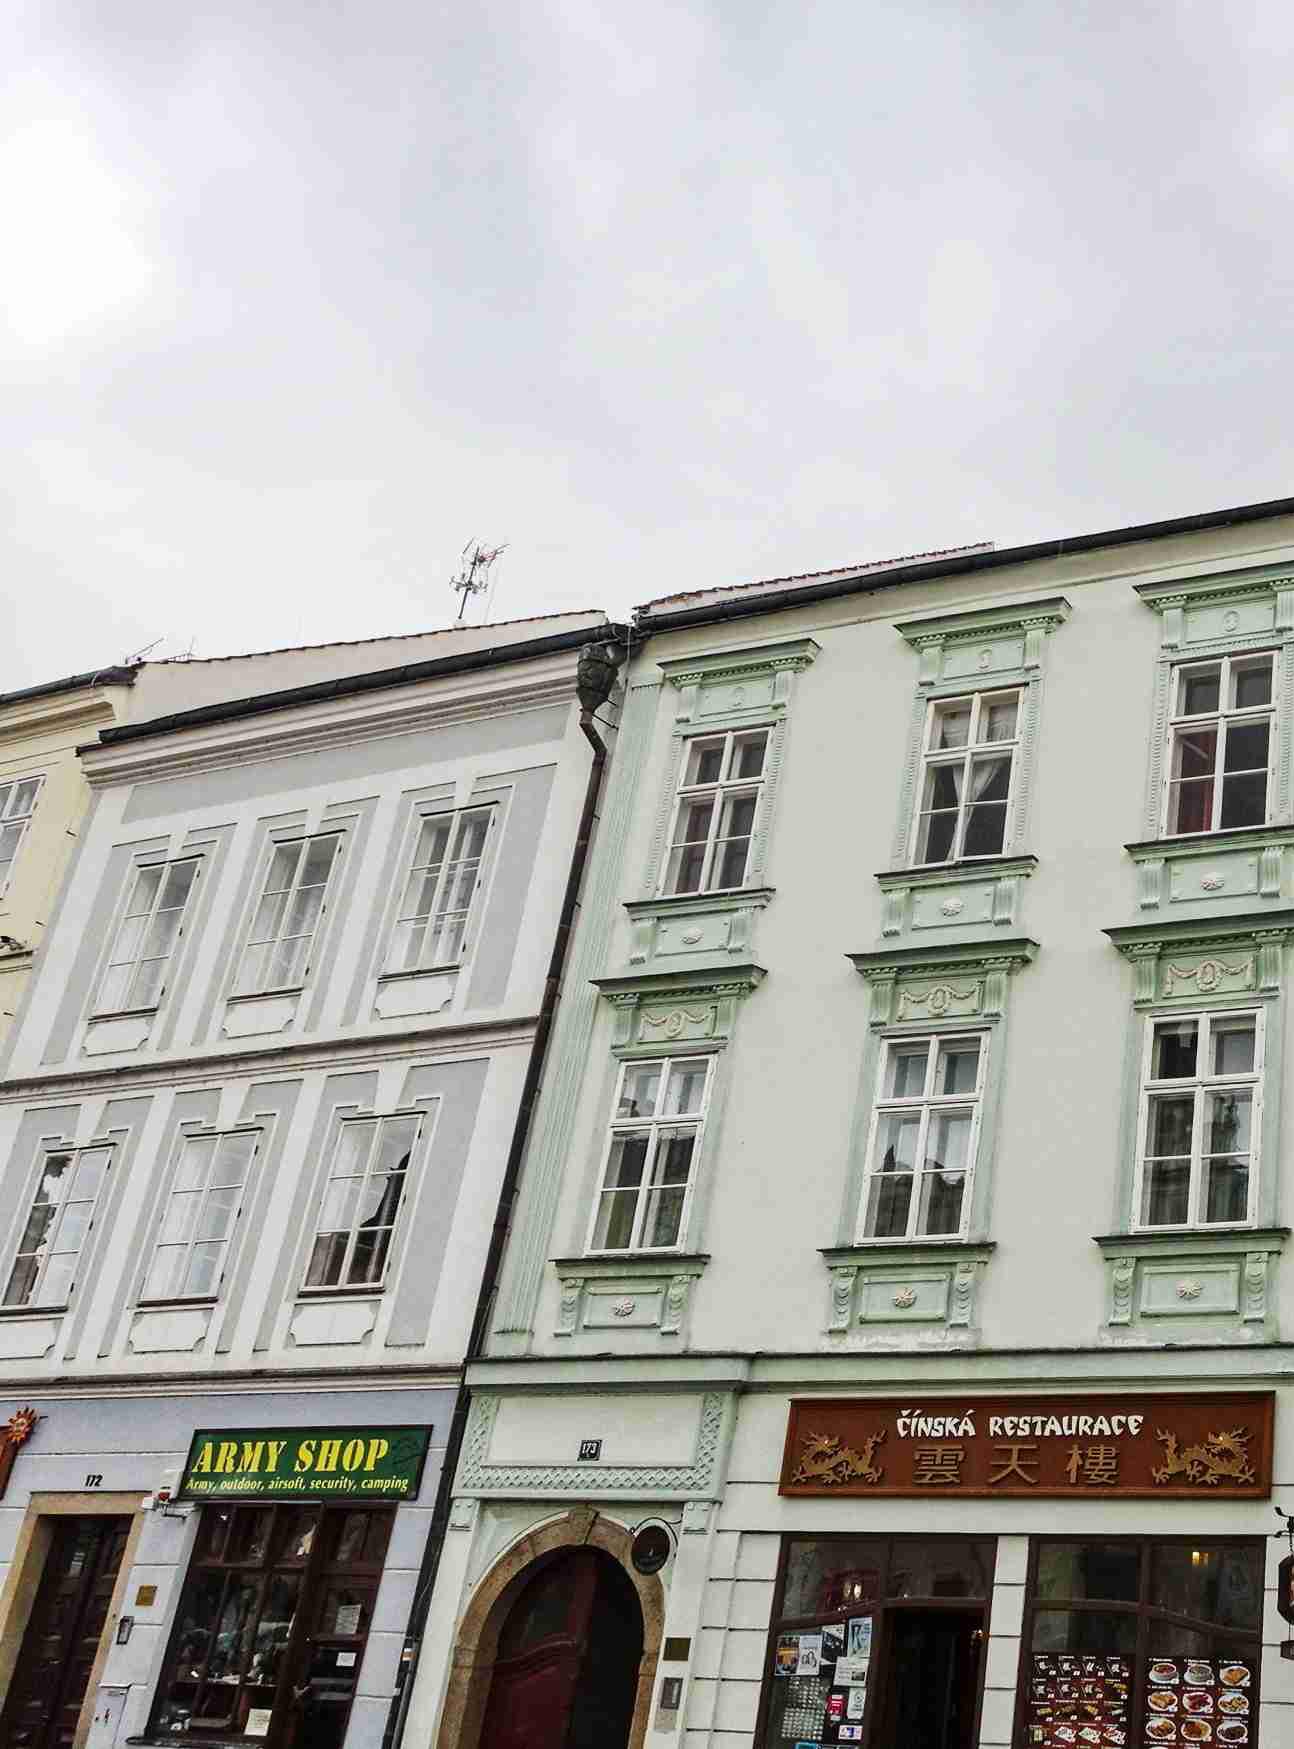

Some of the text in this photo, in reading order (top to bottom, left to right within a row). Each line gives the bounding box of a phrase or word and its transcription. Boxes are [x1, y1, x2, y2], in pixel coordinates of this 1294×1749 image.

[896, 1408, 1144, 1438] ČÍNSKÁ RESTAURACE
[191, 1438, 389, 1473] ARMY SHOP
[913, 1443, 1120, 1484] 雲天樓
[85, 1474, 103, 1487] 172
[186, 1475, 409, 1493] Army, outdoor, airsoft, security, camping
